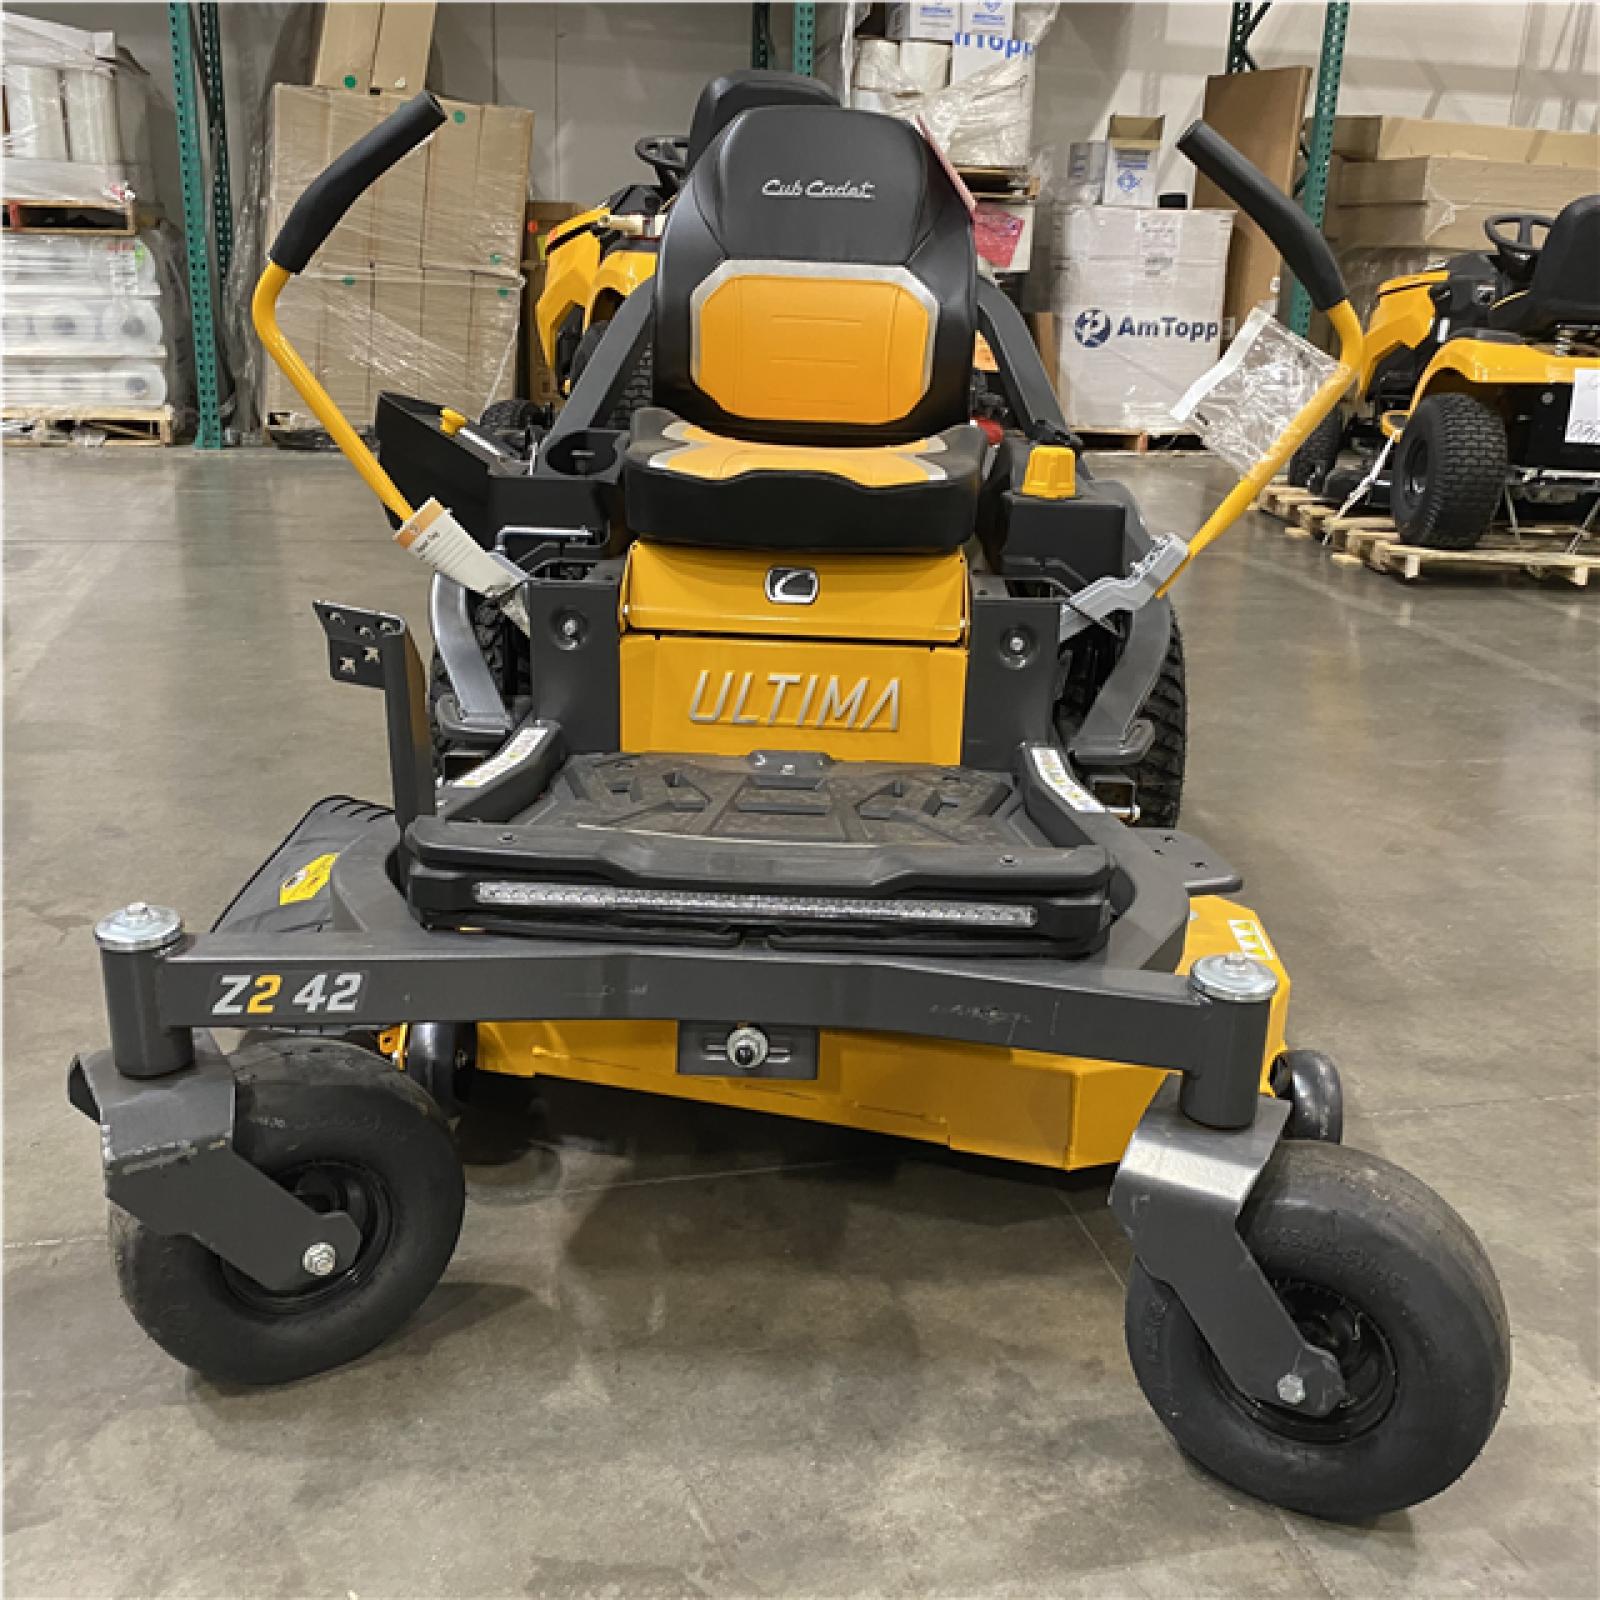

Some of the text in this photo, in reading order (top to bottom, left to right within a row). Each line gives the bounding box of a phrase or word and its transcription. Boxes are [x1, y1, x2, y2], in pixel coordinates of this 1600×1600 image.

[762, 179, 876, 199] Cub Cadet
[1117, 315, 1218, 342] AmTopp
[689, 669, 901, 732] ULTIMA
[211, 972, 363, 1015] Z2 42
